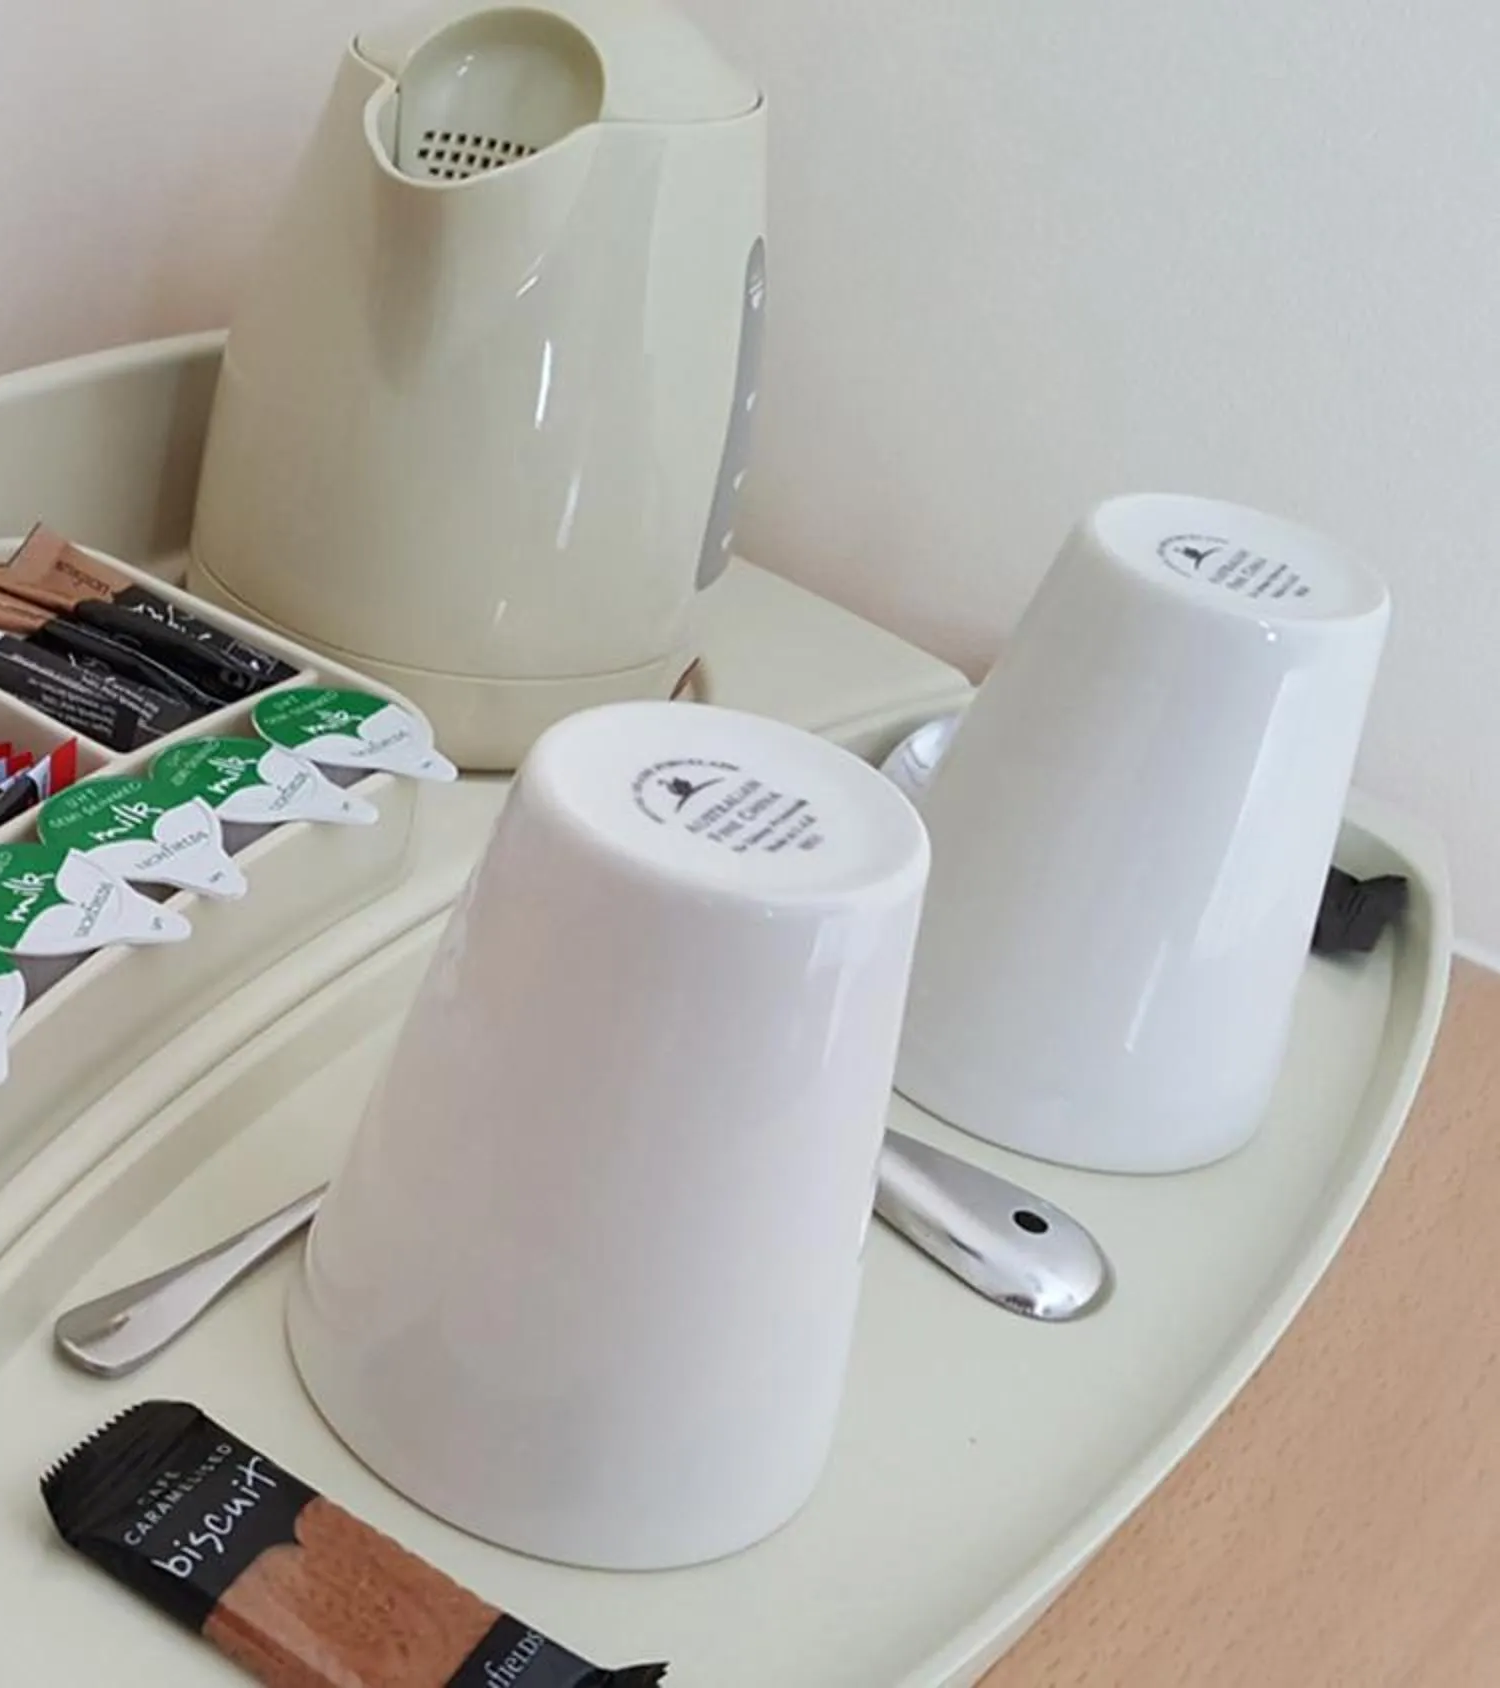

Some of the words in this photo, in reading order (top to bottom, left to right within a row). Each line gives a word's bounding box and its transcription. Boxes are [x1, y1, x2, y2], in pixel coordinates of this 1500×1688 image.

[206, 755, 258, 795] milk
[88, 801, 164, 841] milk
[2, 872, 55, 924] milk
[150, 1455, 277, 1578] biscuit
